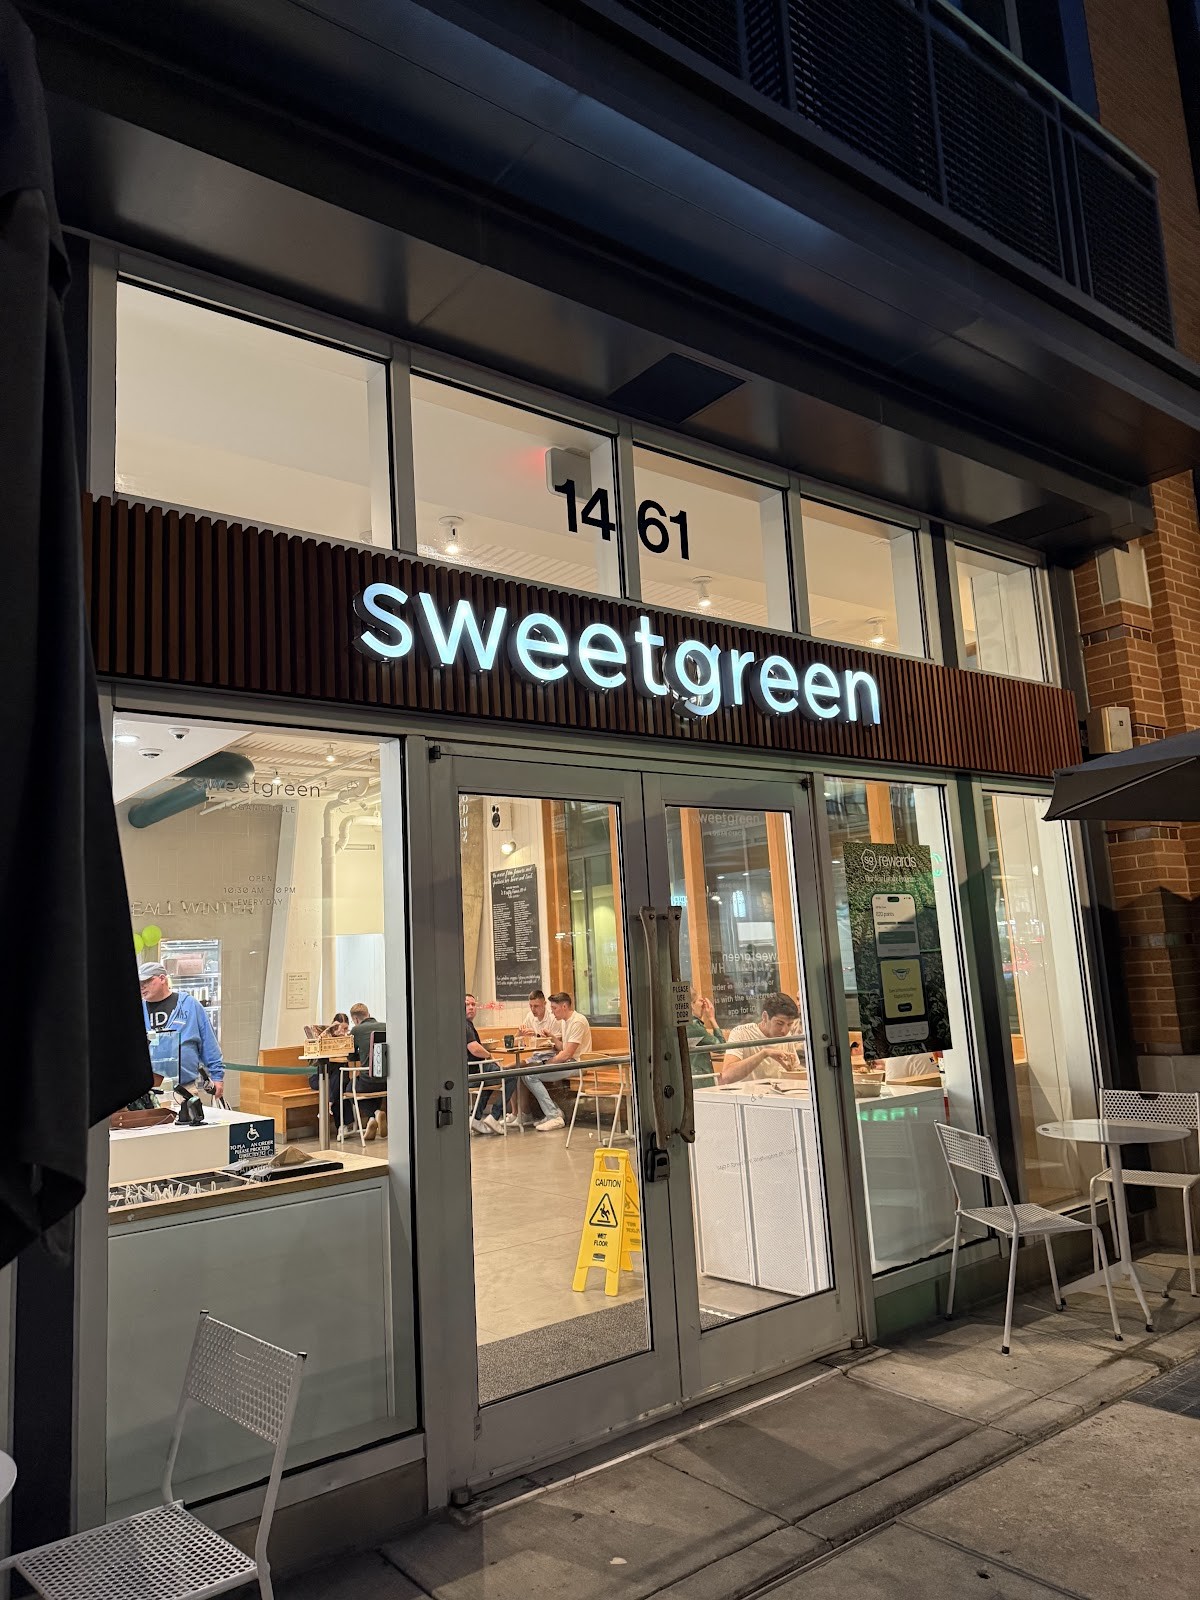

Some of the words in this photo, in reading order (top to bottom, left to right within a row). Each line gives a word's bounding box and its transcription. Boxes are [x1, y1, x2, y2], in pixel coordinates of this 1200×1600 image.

[360, 583, 881, 725] sweetgreen
[193, 778, 320, 798] sweetgreen
[693, 812, 761, 828] weetgreen
[879, 854, 917, 868] rewards
[238, 898, 263, 906] EVERY
[266, 898, 283, 906] DAY
[673, 985, 689, 993] PLEASE
[712, 983, 727, 992] rder
[675, 1002, 689, 1010] OTHER
[595, 1178, 622, 1188] CAUTION
